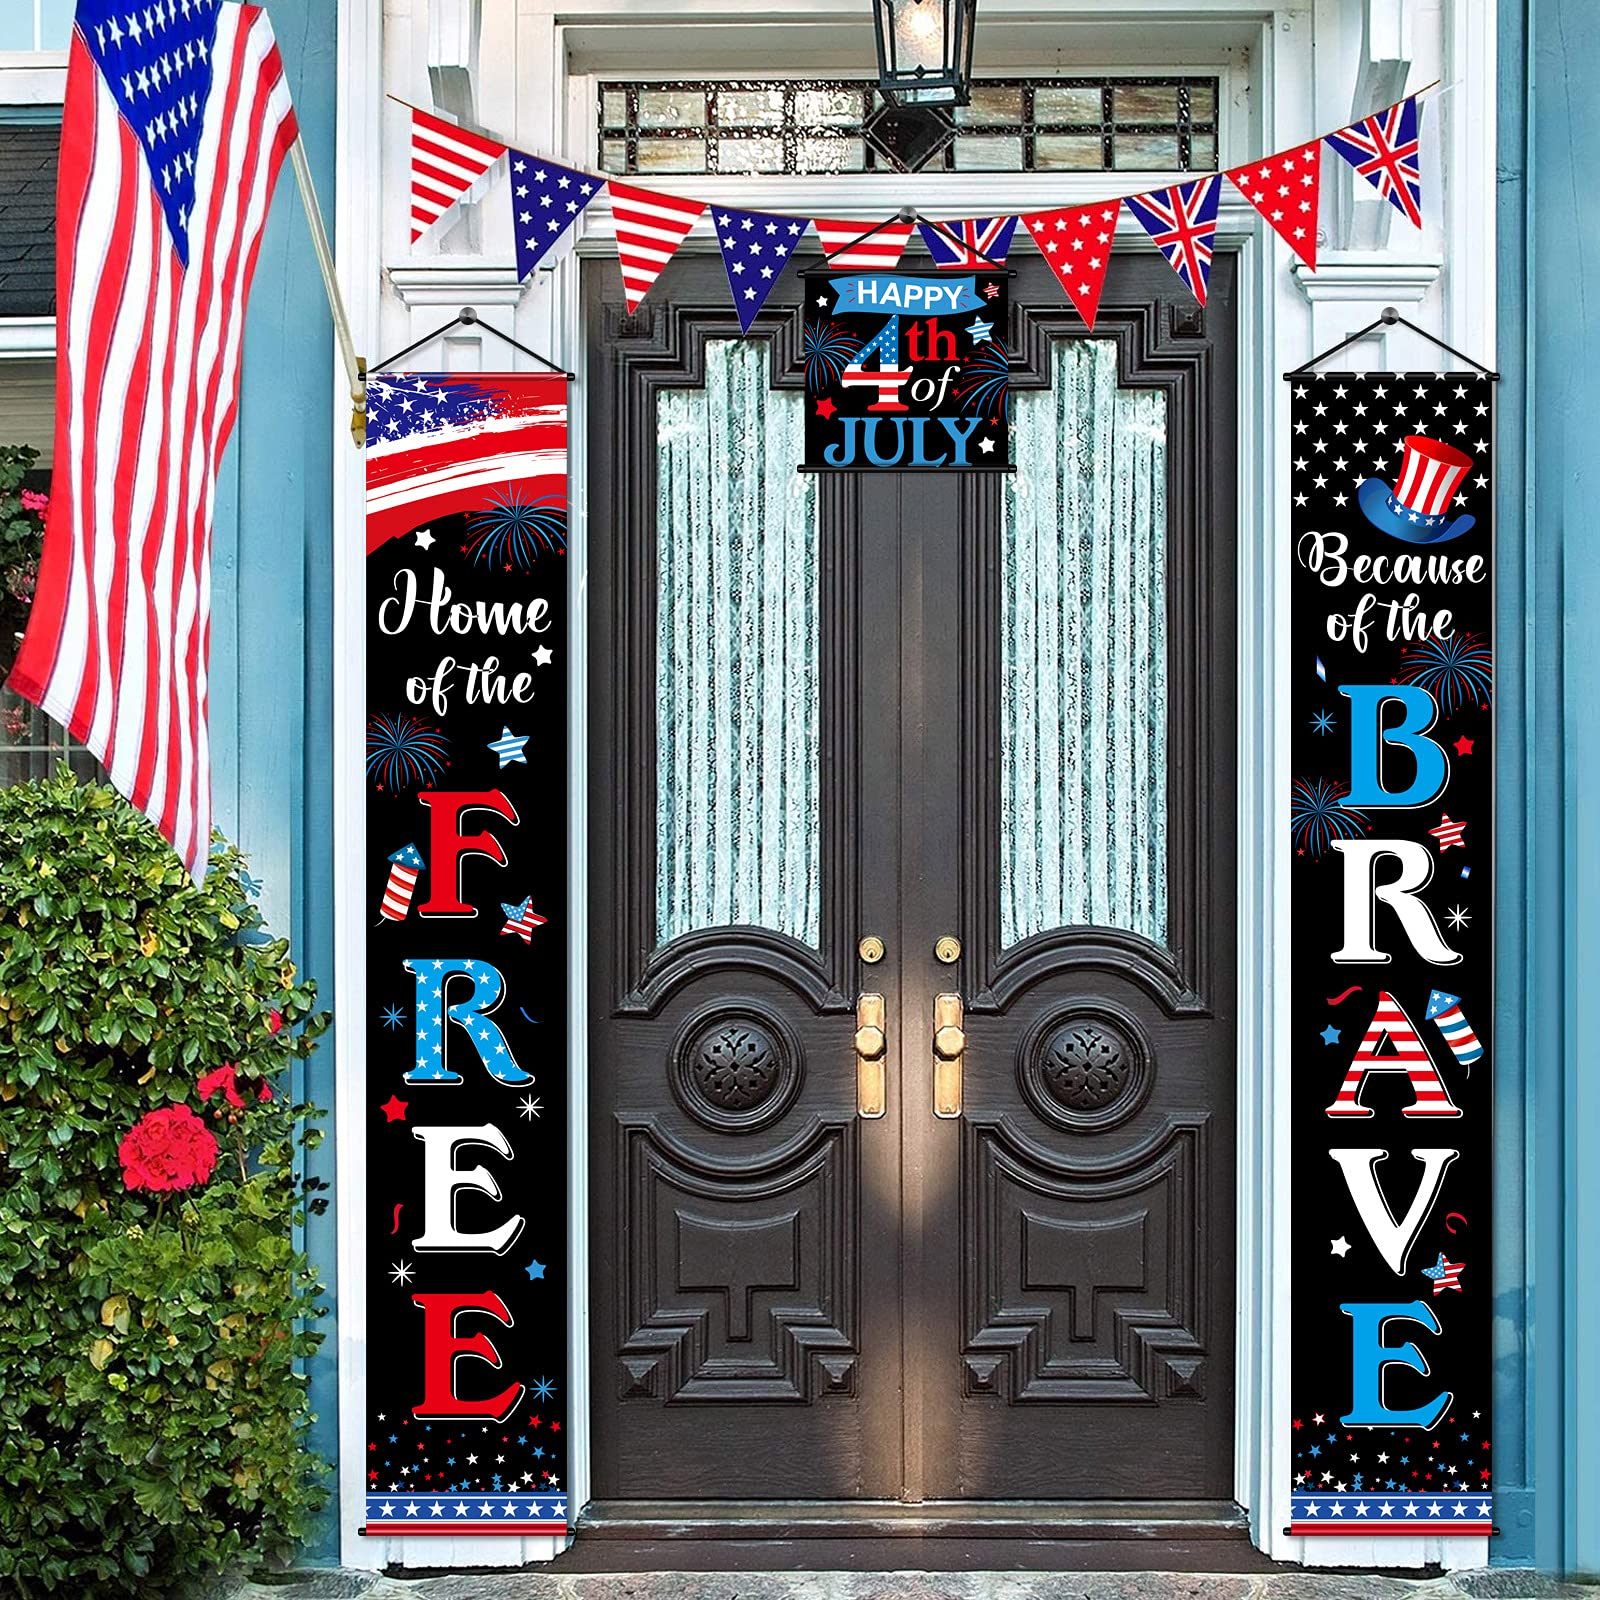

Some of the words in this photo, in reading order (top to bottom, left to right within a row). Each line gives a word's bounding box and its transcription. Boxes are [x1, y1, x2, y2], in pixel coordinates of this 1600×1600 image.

[857, 280, 963, 310] HAPPY
[841, 314, 960, 412] 4th
[911, 365, 961, 412] of
[823, 417, 983, 468] JULY
[1297, 531, 1487, 587] Because
[378, 567, 552, 635] Home
[1326, 593, 1377, 654] of
[1377, 593, 1456, 641] the
[406, 656, 456, 717] of
[456, 656, 535, 705] the
[1324, 684, 1464, 1432] BRAVE
[402, 788, 535, 1424] FREE
